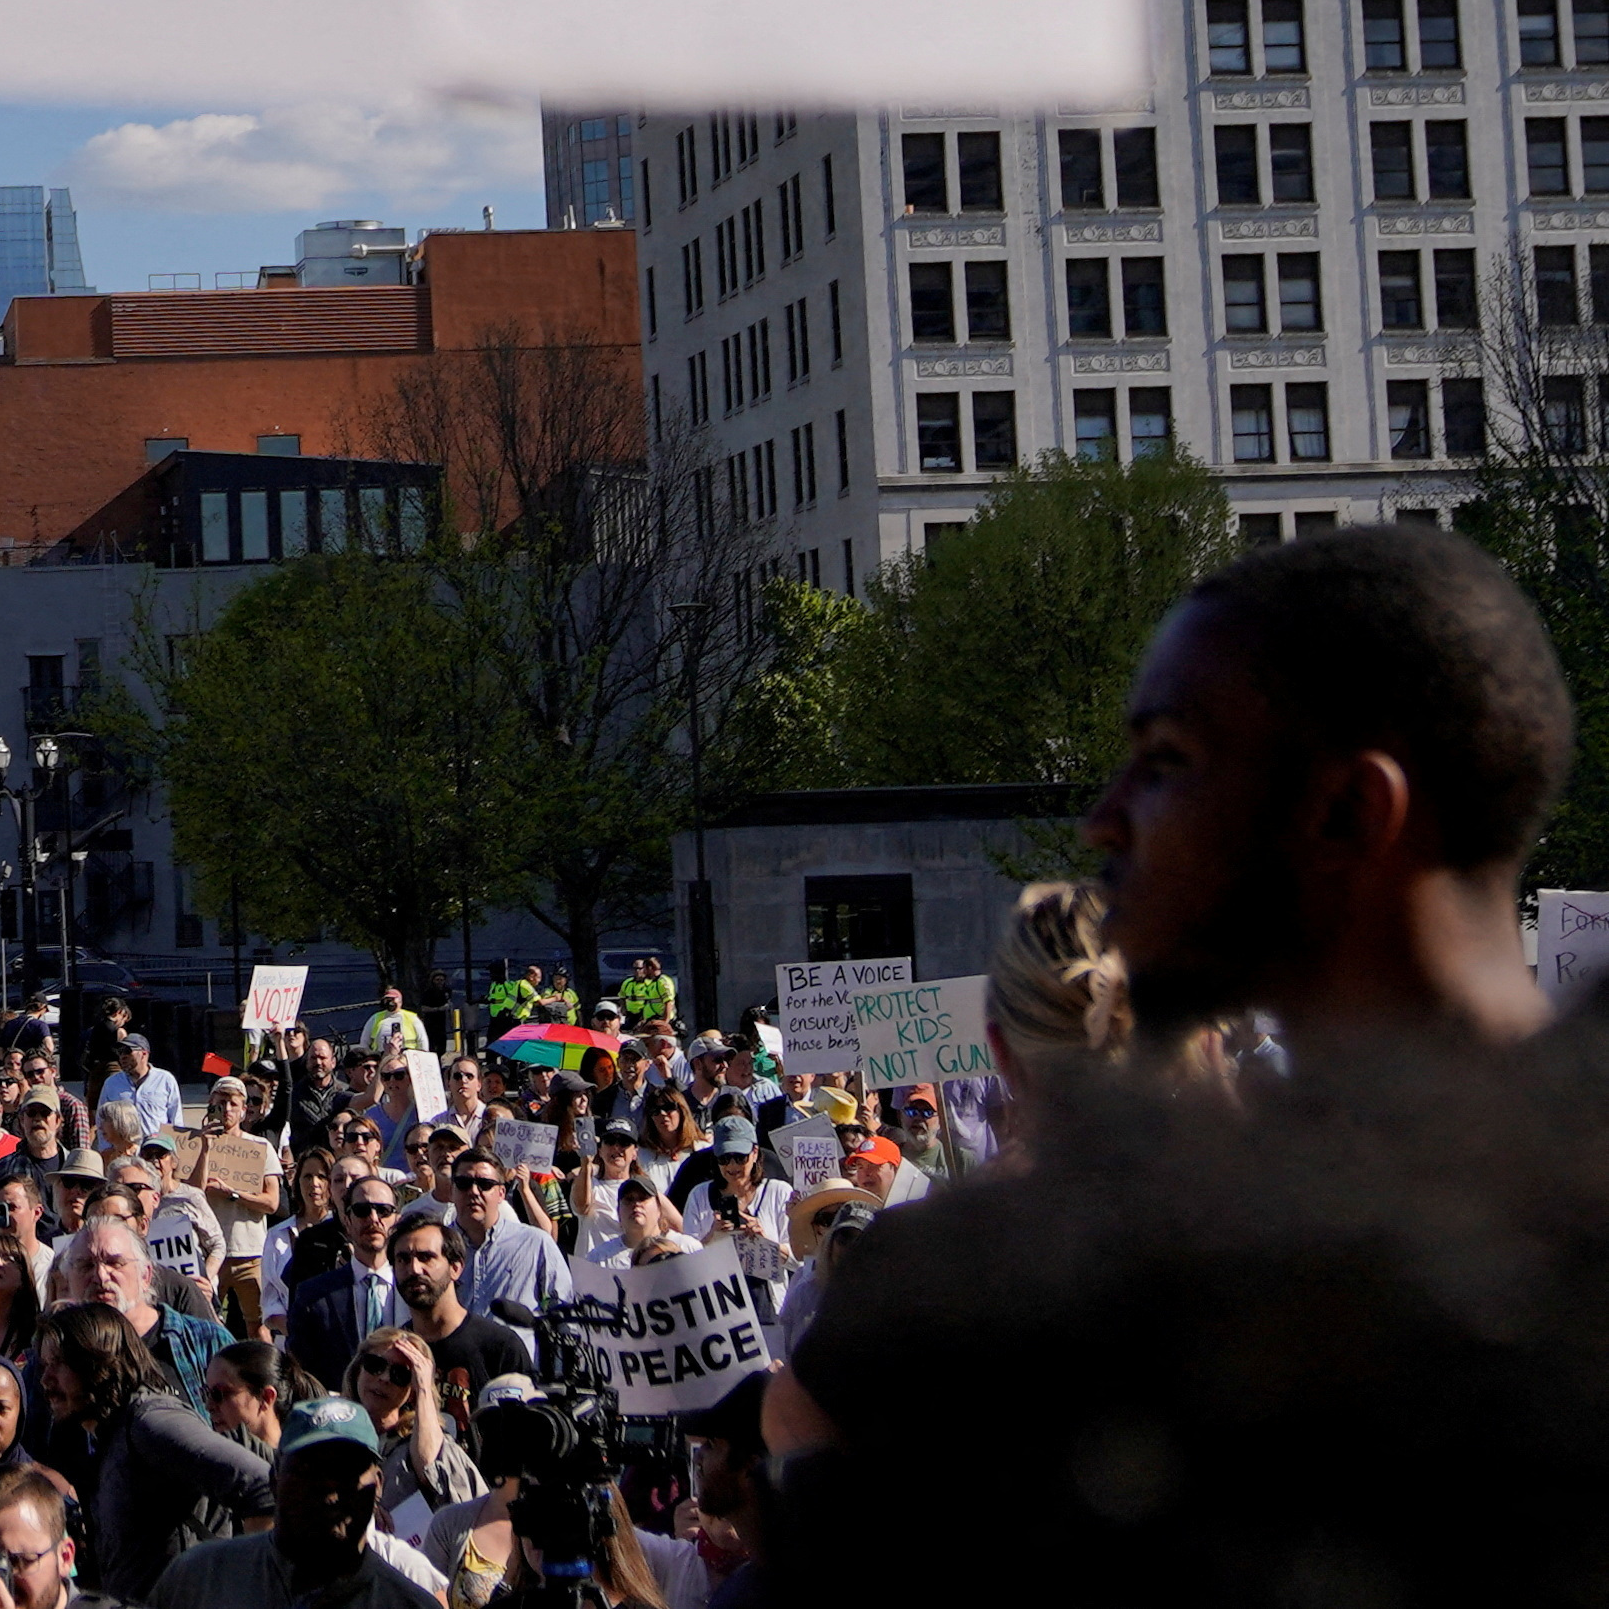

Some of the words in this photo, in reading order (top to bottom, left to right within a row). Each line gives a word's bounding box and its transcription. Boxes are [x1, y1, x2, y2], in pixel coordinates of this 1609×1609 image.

[832, 965, 846, 986] A
[852, 965, 904, 985] VOICE
[254, 985, 303, 1023] VOTE!
[786, 995, 806, 1010] for
[811, 992, 833, 1007] the
[853, 987, 942, 1025] PROTECT
[790, 1015, 842, 1033] ensure
[896, 1013, 953, 1047] KIDS
[787, 1038, 823, 1053] those
[828, 1034, 860, 1053] being
[869, 1049, 918, 1086] NOT
[936, 1042, 996, 1075] GUN
[797, 1142, 832, 1155] PLEASE
[794, 1155, 836, 1170] PROTECT
[618, 1321, 762, 1388] PEACE
